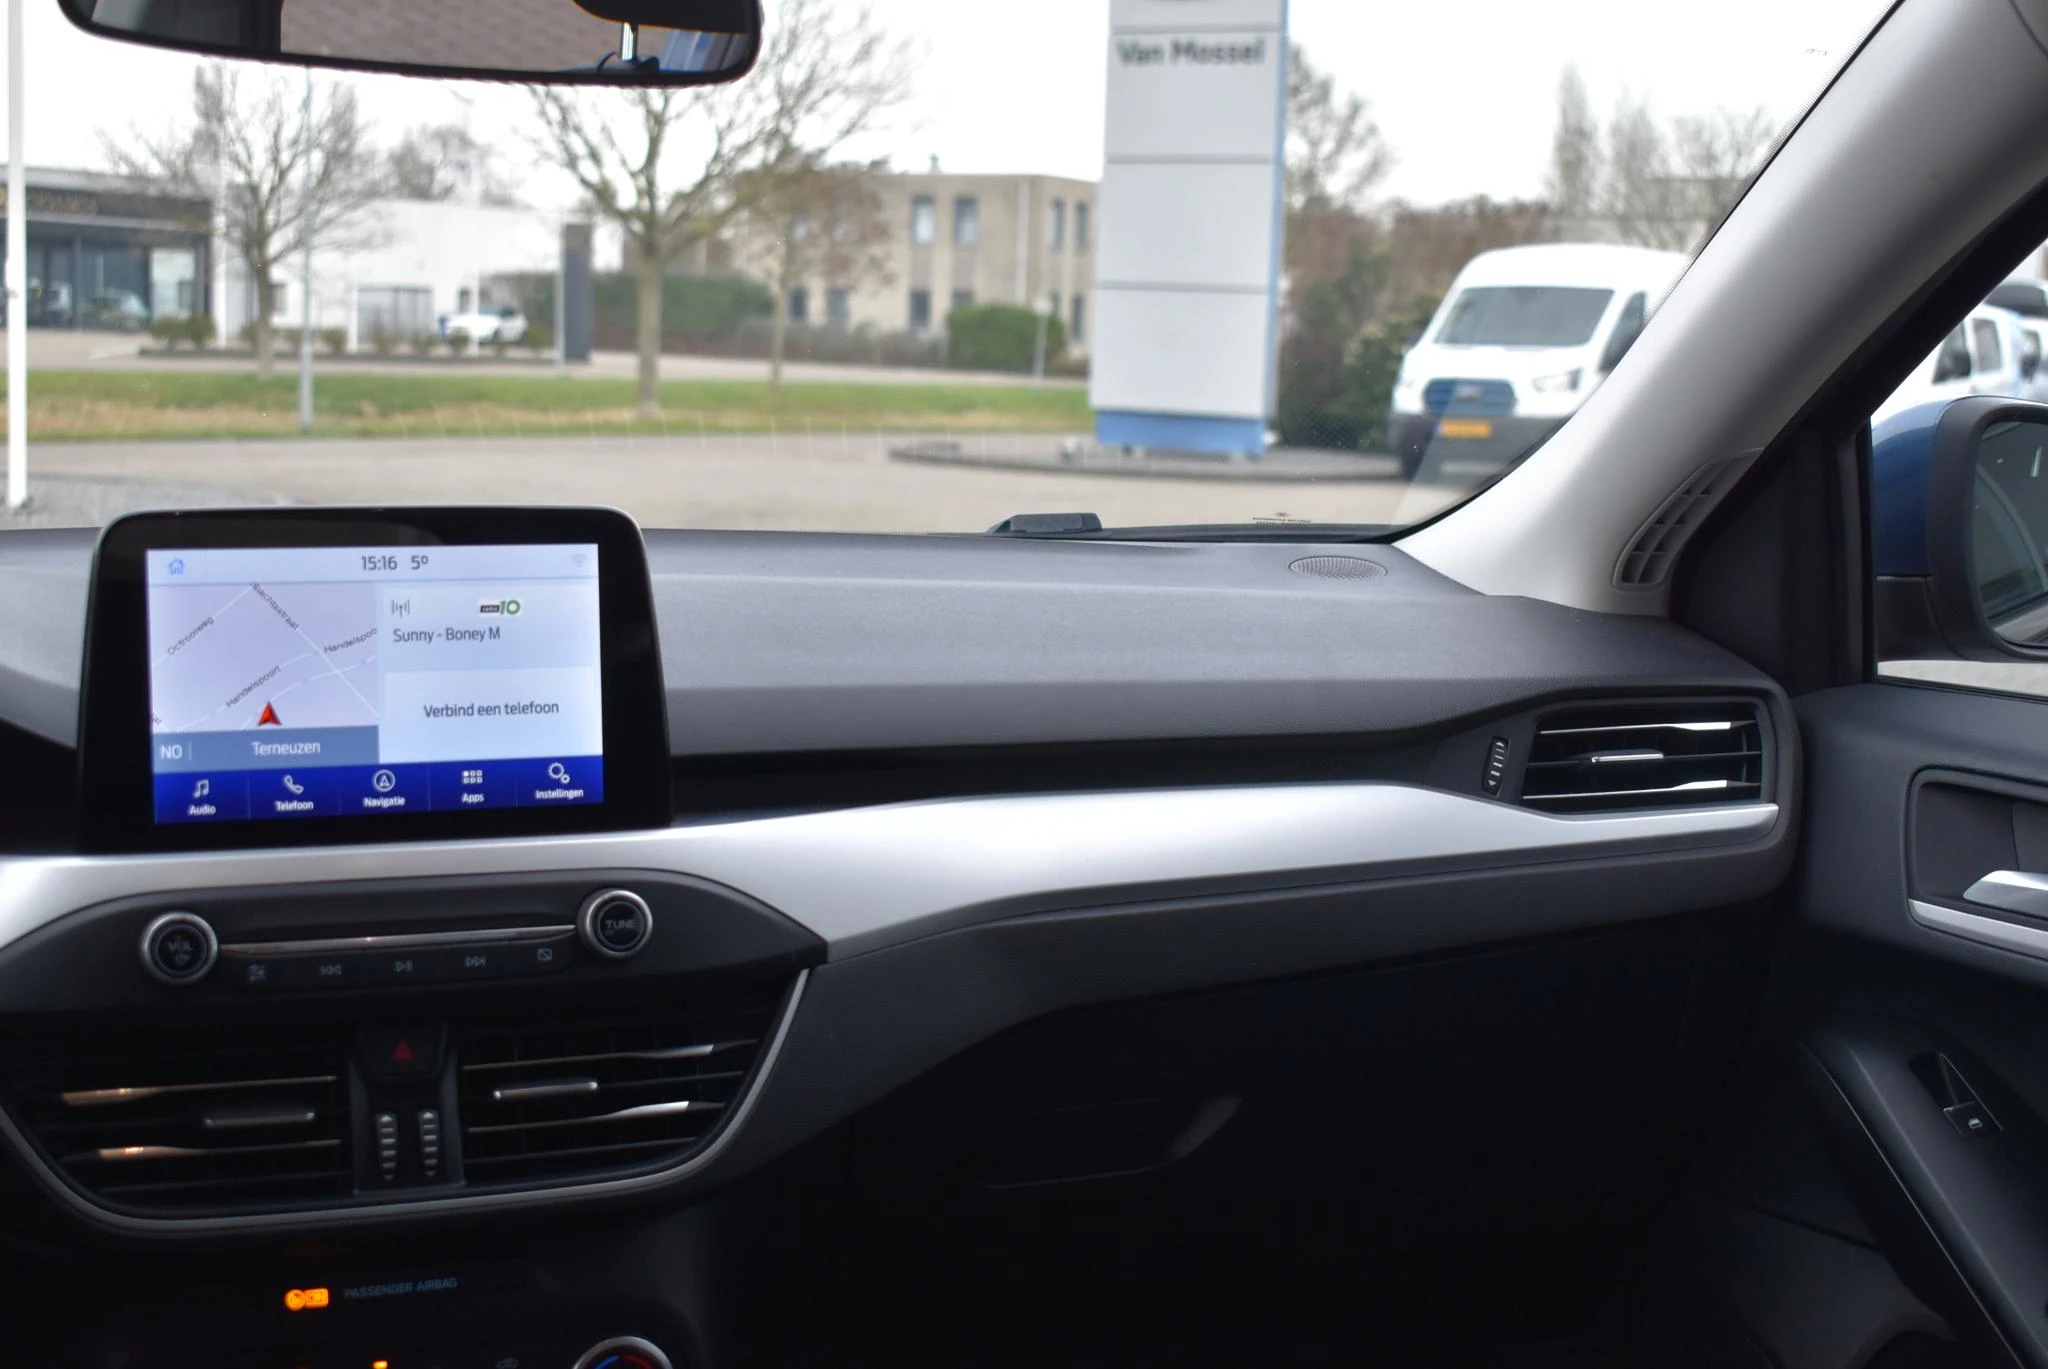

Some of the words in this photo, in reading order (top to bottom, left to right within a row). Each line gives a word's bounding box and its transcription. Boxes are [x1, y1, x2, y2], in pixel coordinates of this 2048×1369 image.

[1115, 37, 1164, 67] Van
[1169, 34, 1265, 66] Mossel
[361, 556, 398, 571] 15:16
[393, 628, 434, 644] Sunny
[446, 627, 486, 643] Boney
[490, 626, 501, 640] M
[424, 703, 475, 718] Verbind
[478, 705, 502, 717] een
[504, 702, 560, 716] telefoon
[160, 744, 183, 760] NO
[252, 741, 321, 756] Terneuzen
[188, 804, 217, 816] Audio
[275, 800, 314, 812] Telefoon
[363, 795, 406, 808] Navigatie
[462, 792, 485, 804] Apps
[535, 788, 584, 801] Instellingen
[604, 919, 637, 930] TUNE
[343, 1281, 414, 1300] PASSENGER
[416, 1276, 458, 1292] AIRBAG
